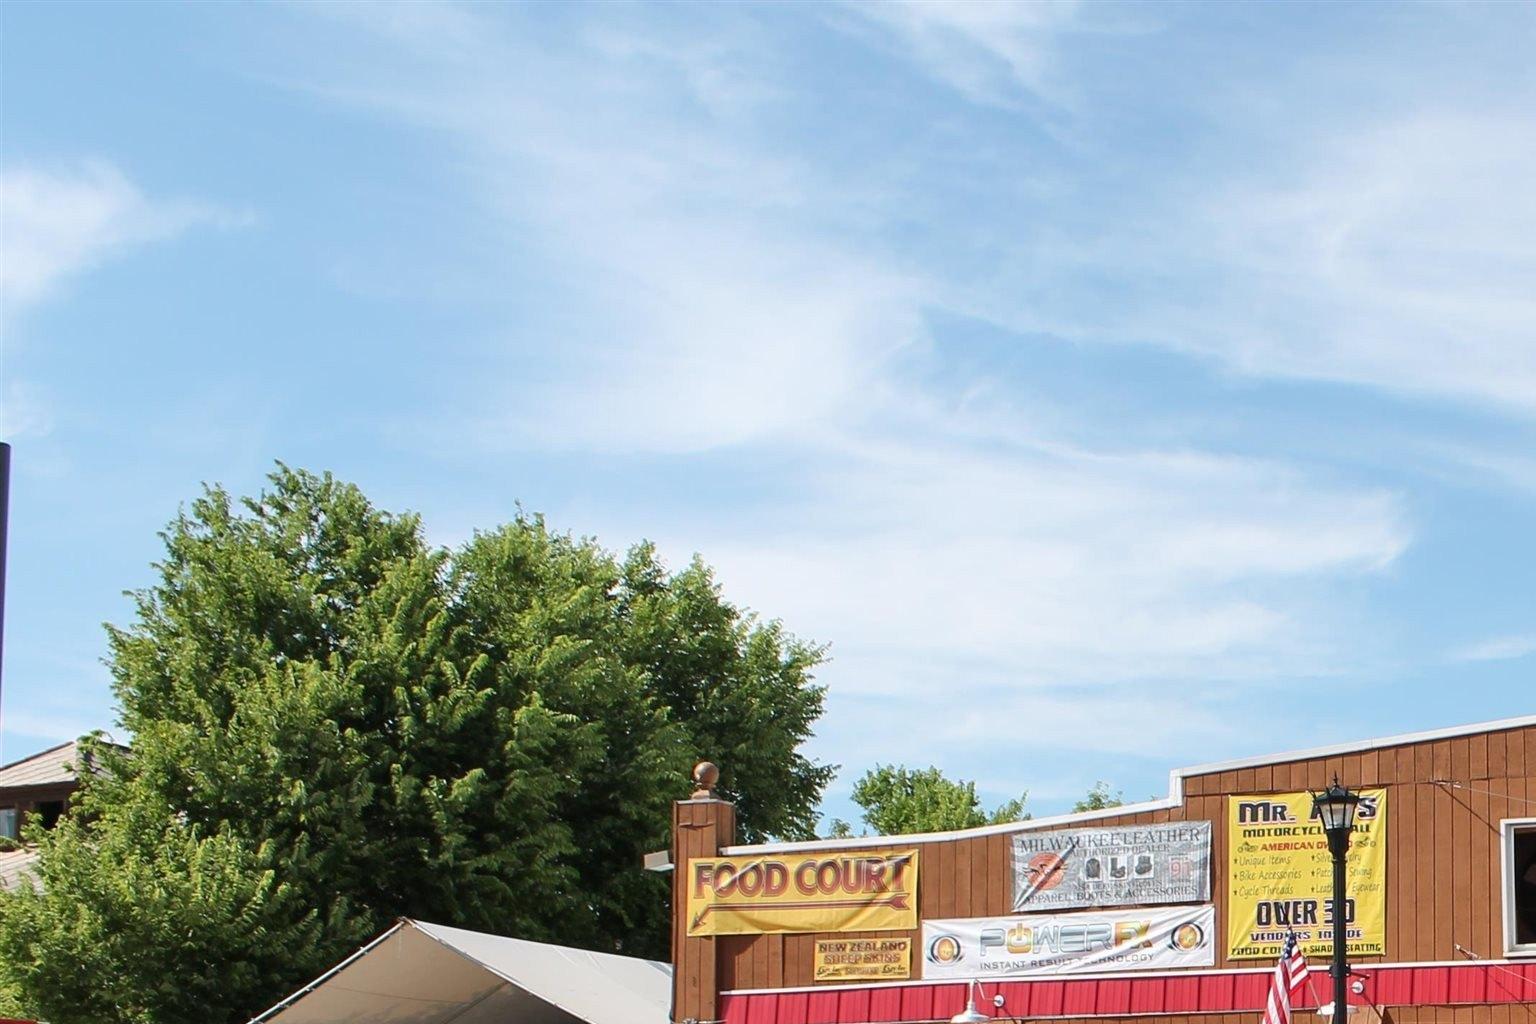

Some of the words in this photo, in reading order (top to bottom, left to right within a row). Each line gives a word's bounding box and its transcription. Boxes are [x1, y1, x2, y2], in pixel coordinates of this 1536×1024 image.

[1243, 826, 1326, 838] MOTORCYCL
[1351, 824, 1371, 833] ALL
[1020, 832, 1121, 853] MILWAUKEE
[1123, 828, 1200, 846] LEATHER
[1260, 841, 1314, 852] AMERICAN
[1072, 846, 1129, 857] AUTHORIZED
[1131, 844, 1170, 853] DEALER
[1238, 856, 1267, 868] Unique
[1269, 855, 1291, 865] Items
[1315, 853, 1334, 863] Silve
[693, 860, 790, 899] FOOD
[793, 855, 913, 897] COURT
[1239, 870, 1256, 881] Bike
[1258, 869, 1302, 880] Accessories
[1076, 890, 1112, 901] BOOTS
[1125, 886, 1198, 899] ACCESSORIES
[1261, 886, 1294, 895] Threads
[1257, 900, 1318, 926] OVER
[1250, 931, 1310, 942] VENDRS
[819, 942, 847, 953] NEW
[849, 940, 907, 952] ZEALAND
[1310, 944, 1333, 953] SHAD
[980, 960, 1026, 970] INSTANT
